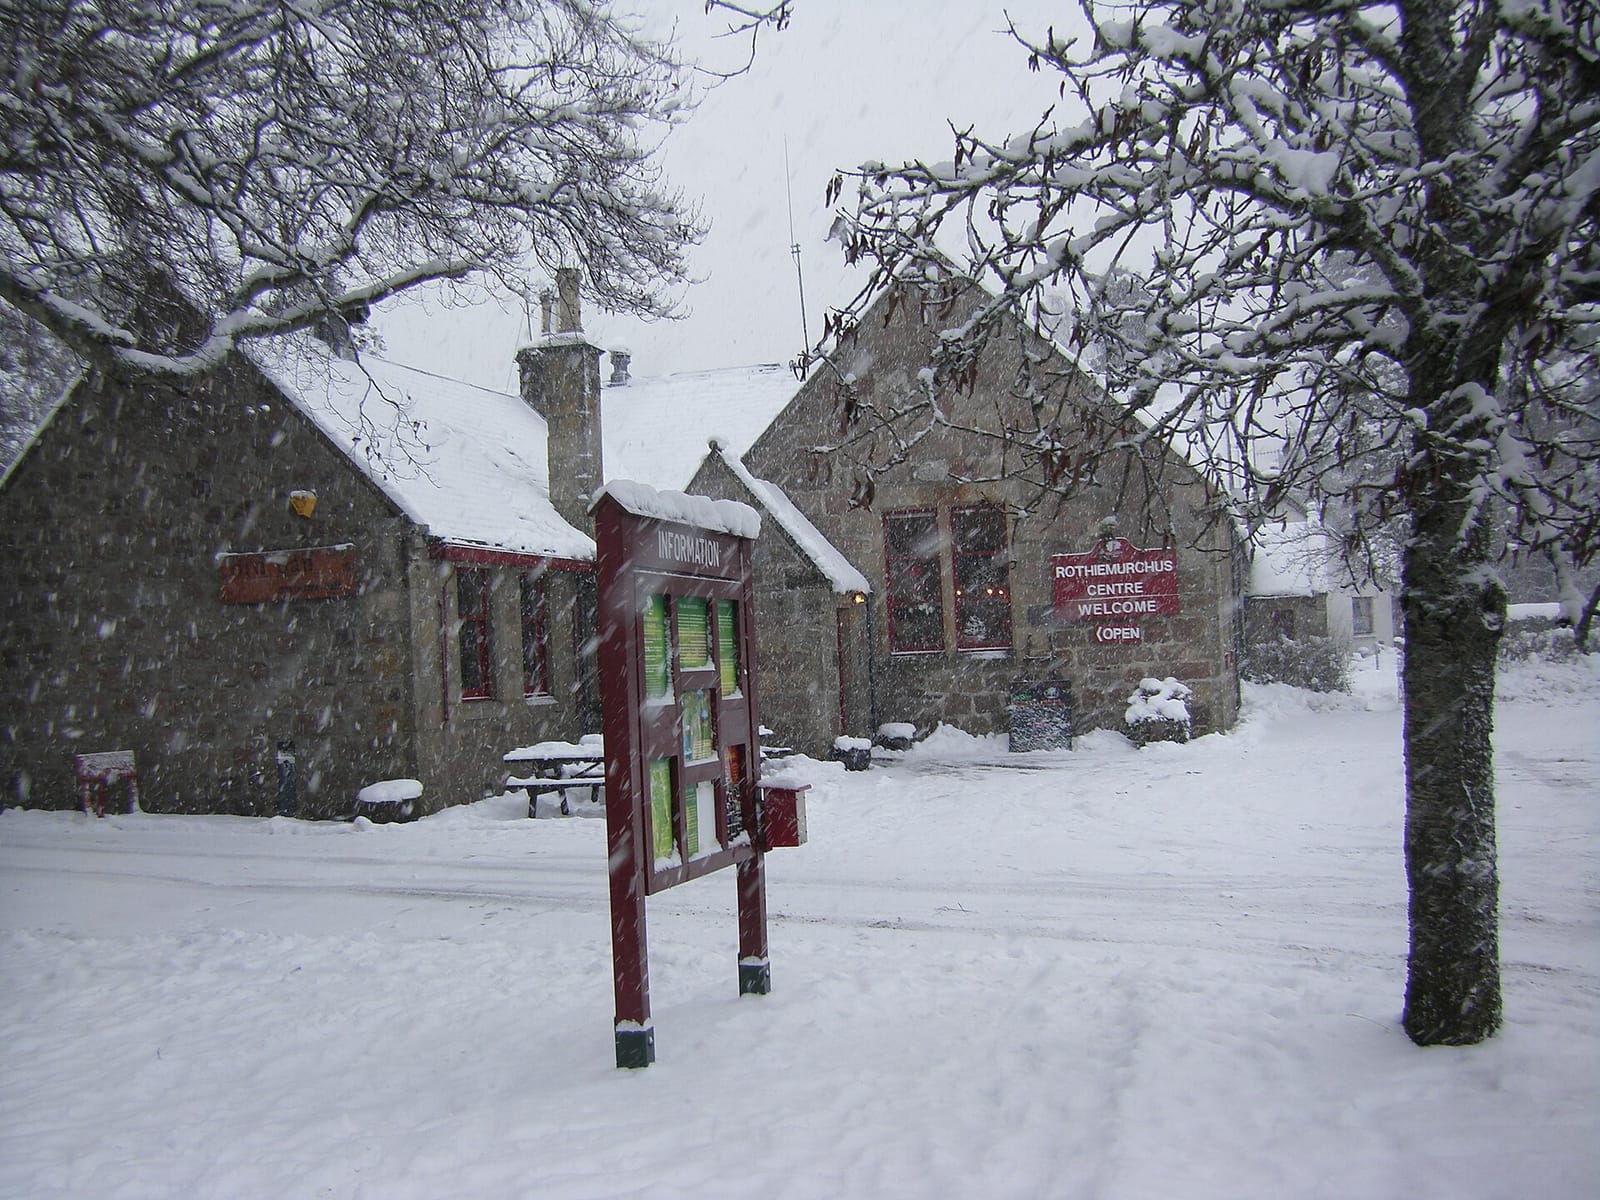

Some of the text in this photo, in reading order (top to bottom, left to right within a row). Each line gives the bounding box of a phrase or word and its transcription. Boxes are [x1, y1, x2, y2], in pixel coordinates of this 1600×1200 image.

[658, 530, 720, 567] INFORMATION
[1055, 560, 1173, 578] ROTHIEMURCHUS
[1087, 582, 1144, 596] CENTRE
[1078, 601, 1156, 616] WELCOME
[1102, 627, 1140, 640] OPEN
